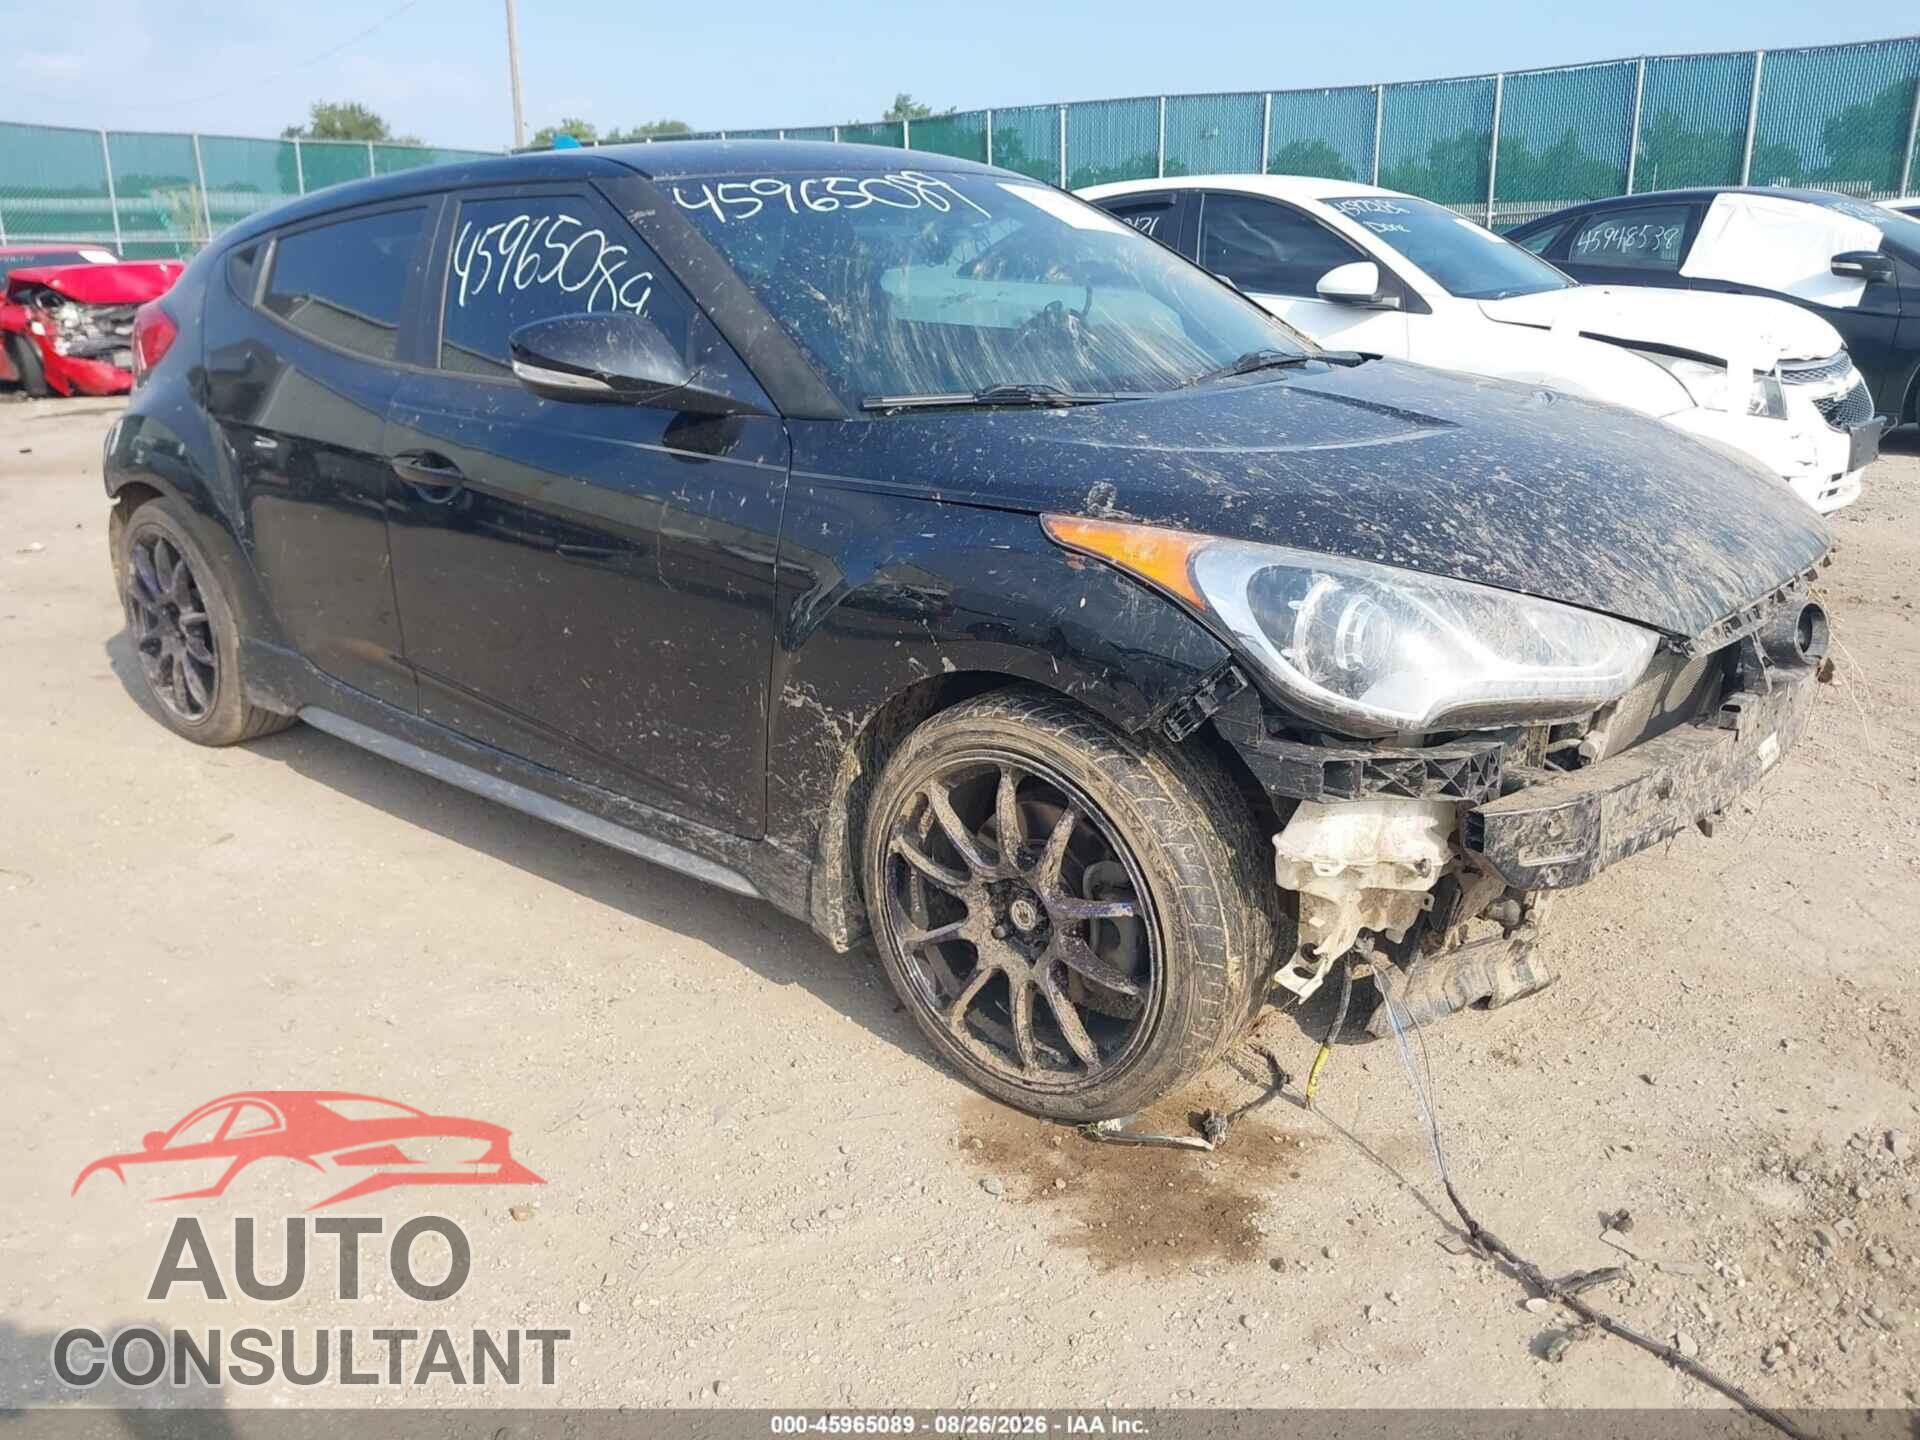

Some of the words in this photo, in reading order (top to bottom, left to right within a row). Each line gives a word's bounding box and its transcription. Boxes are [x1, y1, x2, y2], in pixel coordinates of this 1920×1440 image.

[672, 170, 993, 223] 45965089
[453, 214, 653, 317] 45965089
[1577, 224, 1680, 254] 45948538
